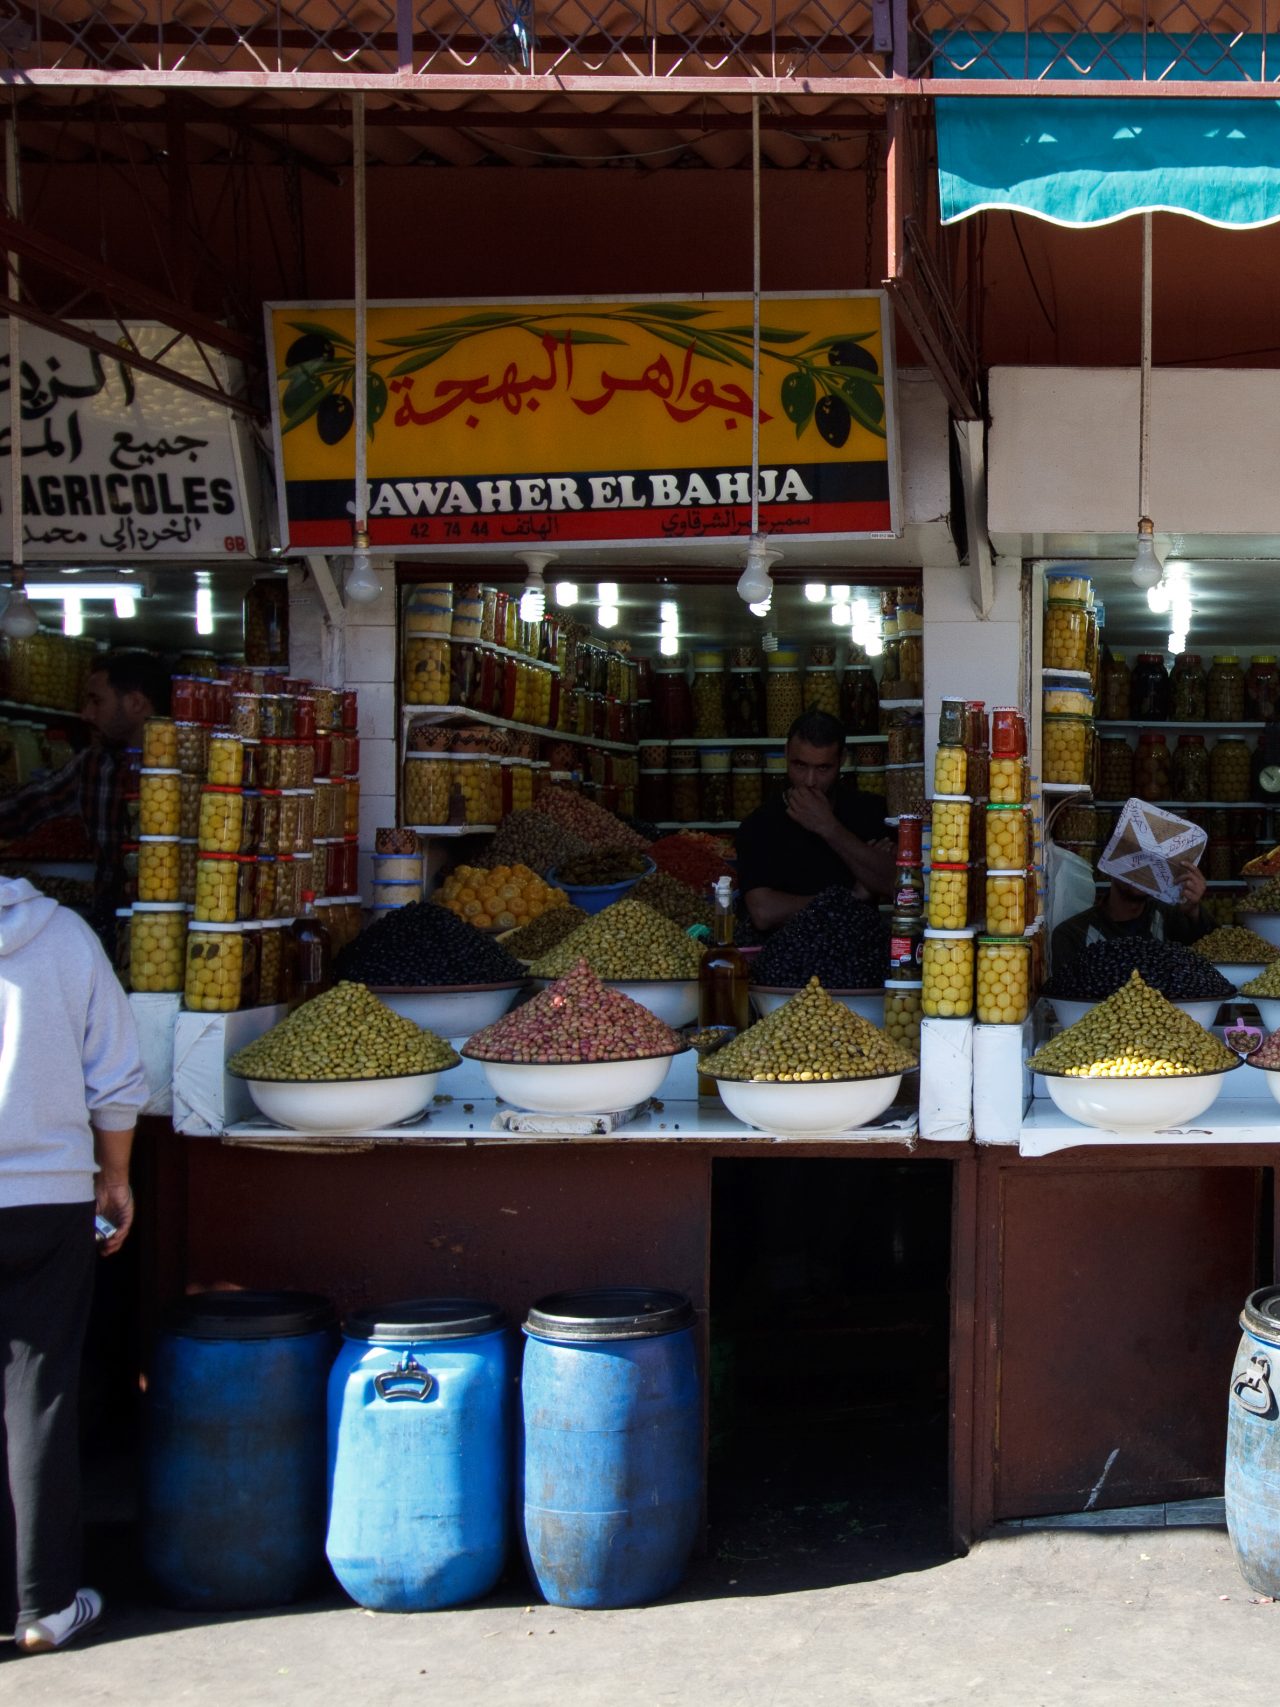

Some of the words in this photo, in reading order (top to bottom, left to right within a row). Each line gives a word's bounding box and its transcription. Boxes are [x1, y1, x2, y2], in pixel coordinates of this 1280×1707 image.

[388, 328, 573, 430] البهجة
[571, 337, 774, 431] جواهر
[110, 432, 208, 470] جميع
[21, 473, 235, 516] AGRICOLES
[346, 476, 585, 515] JAWAHER
[587, 474, 646, 509] EL
[648, 468, 814, 507] BAHJA
[224, 536, 246, 553] GB
[410, 522, 430, 538] 42
[444, 521, 461, 537] 74
[470, 521, 489, 537] 44
